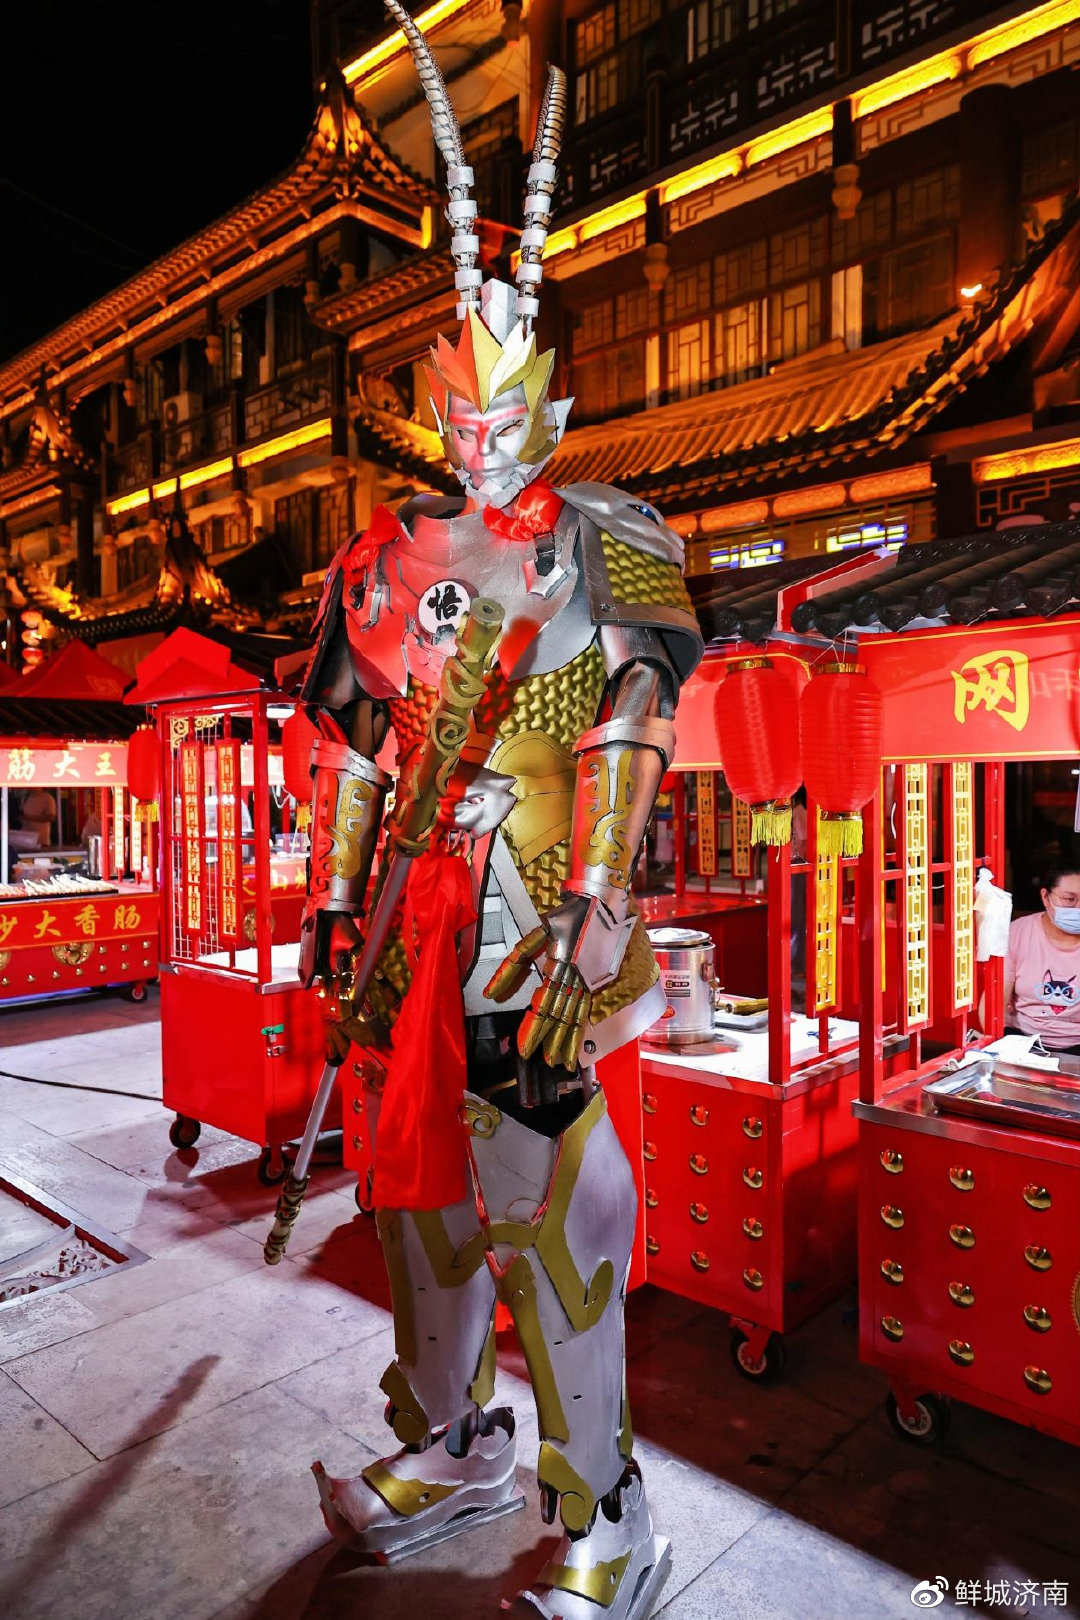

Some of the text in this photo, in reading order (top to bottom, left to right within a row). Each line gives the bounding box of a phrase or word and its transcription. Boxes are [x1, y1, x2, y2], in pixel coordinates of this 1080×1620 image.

[950, 649, 1030, 732] 网
[7, 746, 117, 781] 筋大王
